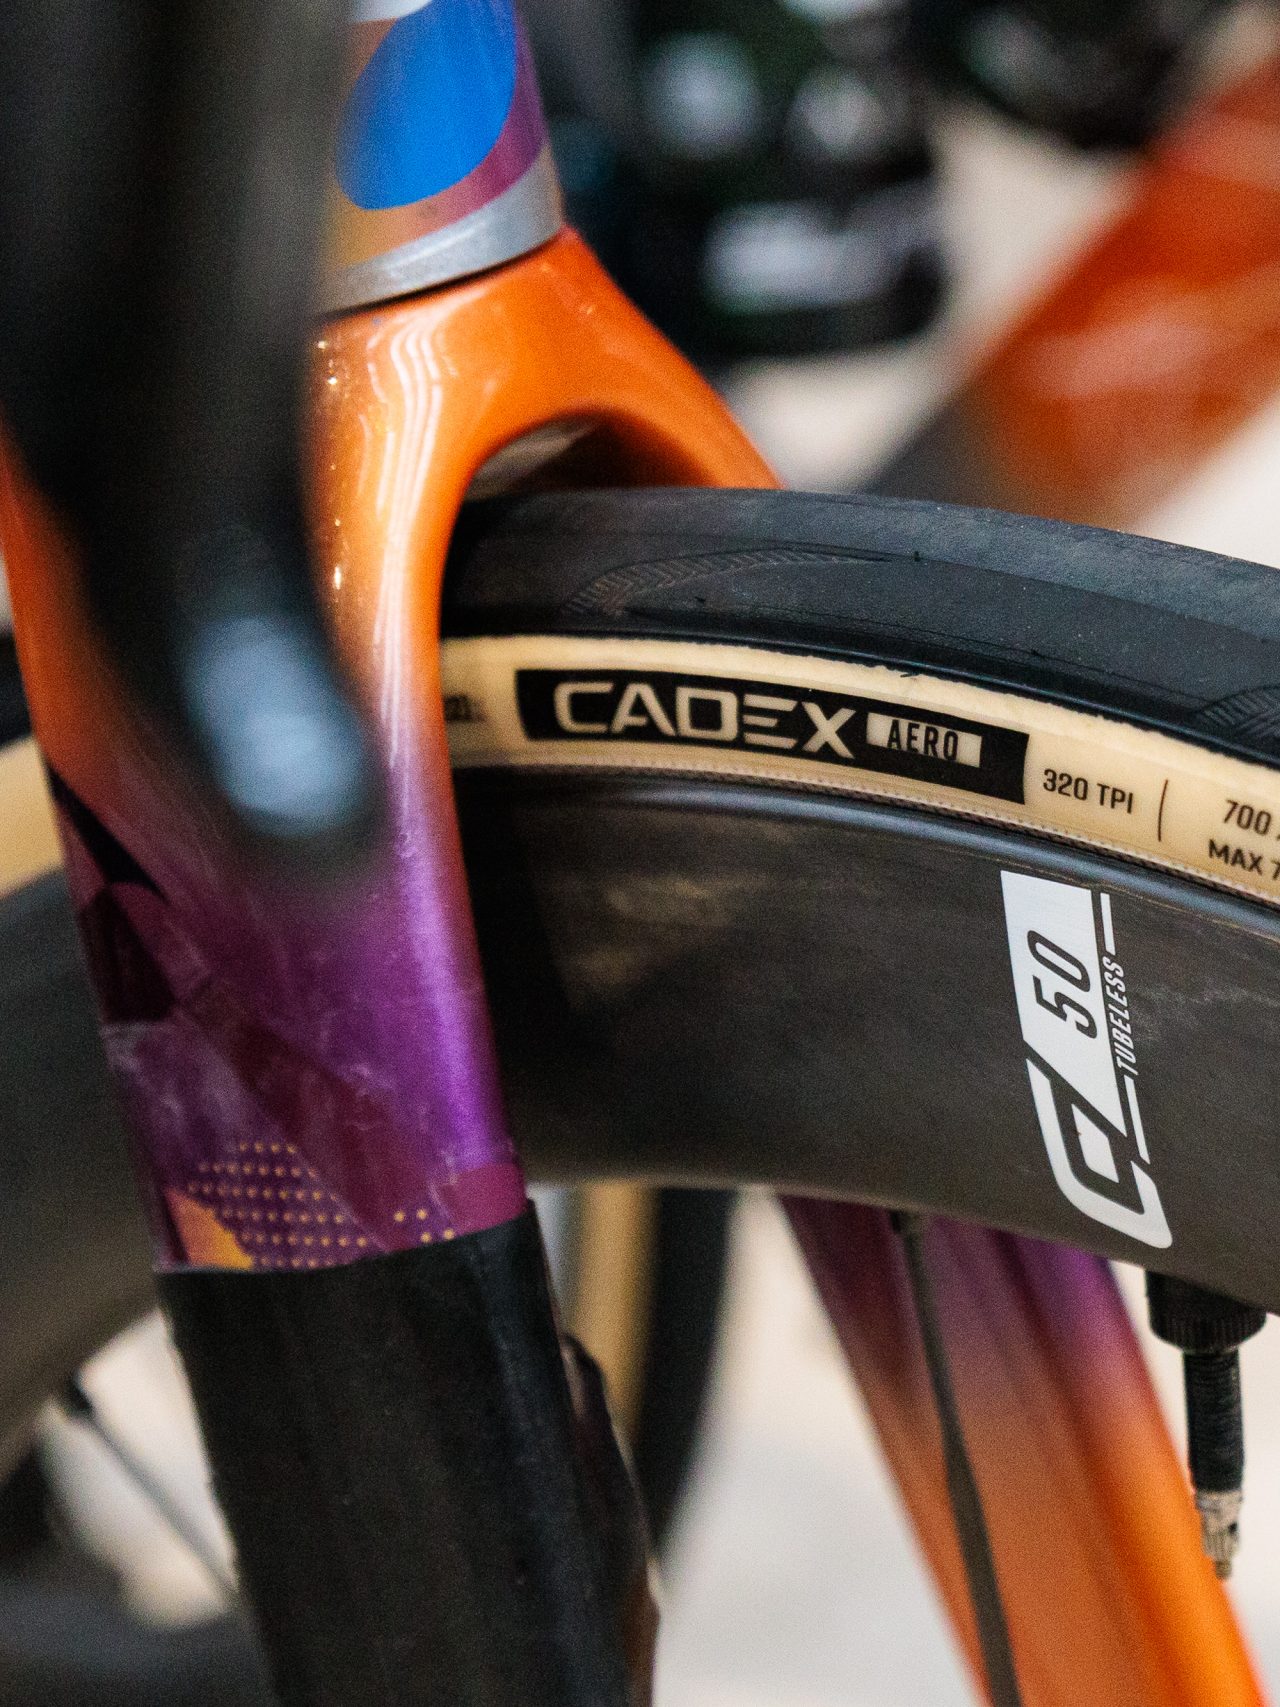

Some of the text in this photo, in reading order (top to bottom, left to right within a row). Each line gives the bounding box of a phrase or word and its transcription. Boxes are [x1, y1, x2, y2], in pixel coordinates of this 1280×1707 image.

[554, 681, 856, 759] CADEX
[886, 718, 960, 763] AERO
[1042, 768, 1132, 814] 320 TPI
[1222, 799, 1272, 835] 700
[1208, 838, 1264, 875] MAX
[1026, 929, 1099, 1040] 50
[1102, 955, 1140, 1077] TUBELESS
